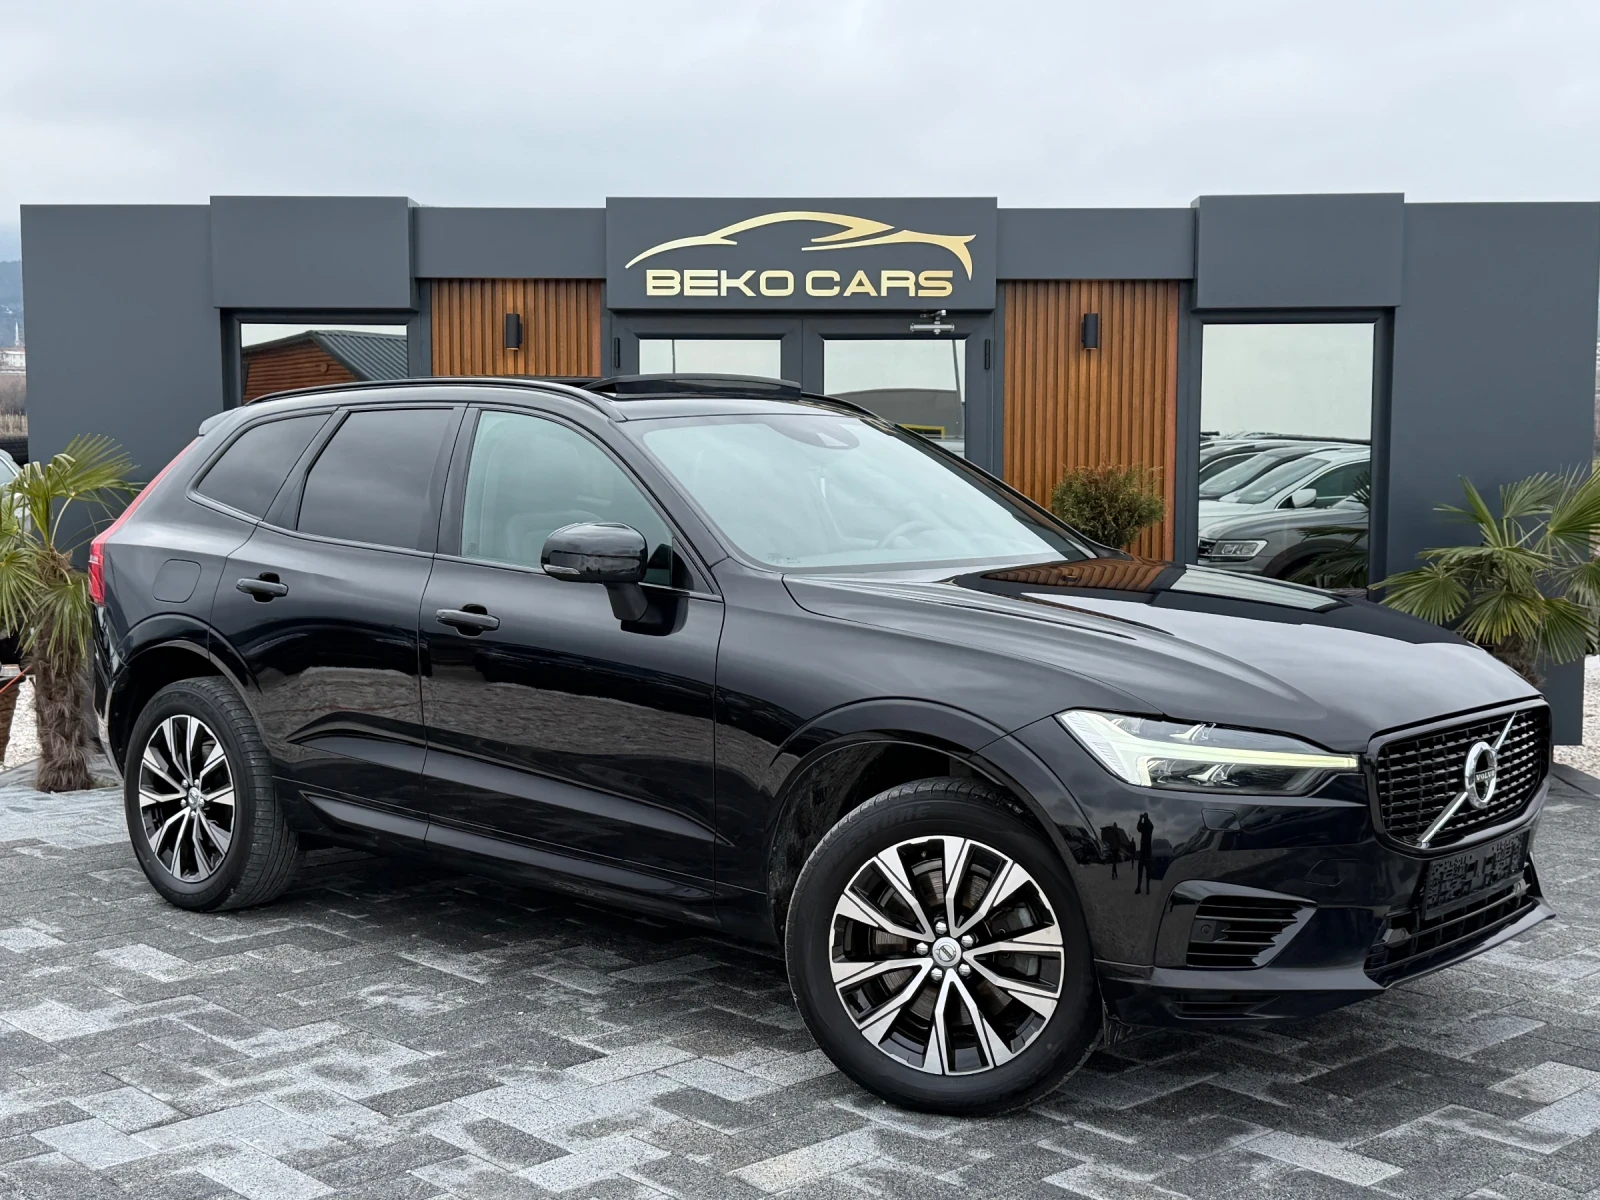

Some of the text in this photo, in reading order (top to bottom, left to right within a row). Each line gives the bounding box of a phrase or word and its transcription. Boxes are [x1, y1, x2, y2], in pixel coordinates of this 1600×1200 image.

[646, 269, 953, 297] BEKO CARS
[1476, 770, 1495, 781] VOLVO
